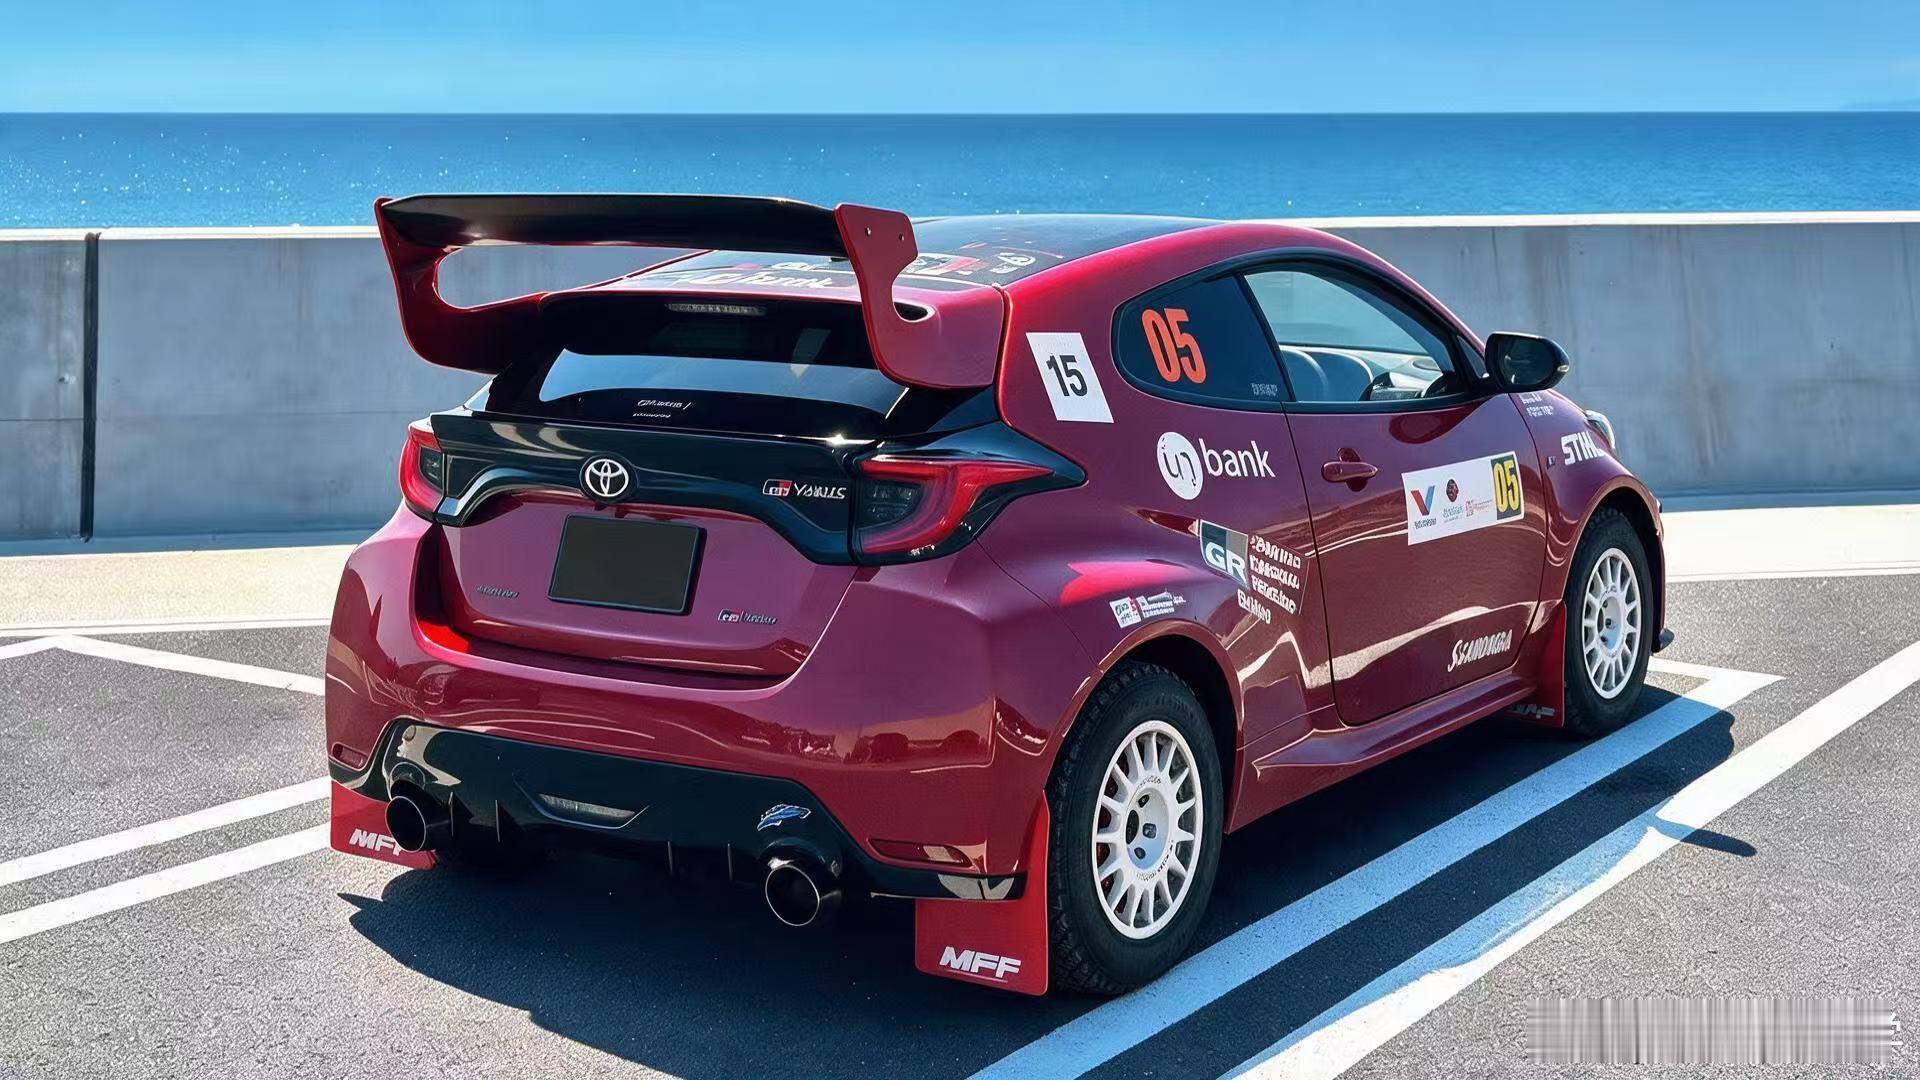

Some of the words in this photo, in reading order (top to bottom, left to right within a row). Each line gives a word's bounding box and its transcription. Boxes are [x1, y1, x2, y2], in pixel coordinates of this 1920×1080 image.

[1141, 307, 1207, 384] 05
[1045, 354, 1088, 397] 15
[1198, 438, 1276, 478] bank
[1493, 459, 1520, 513] 05
[1205, 541, 1248, 588] GR
[939, 945, 1022, 979] MFF
